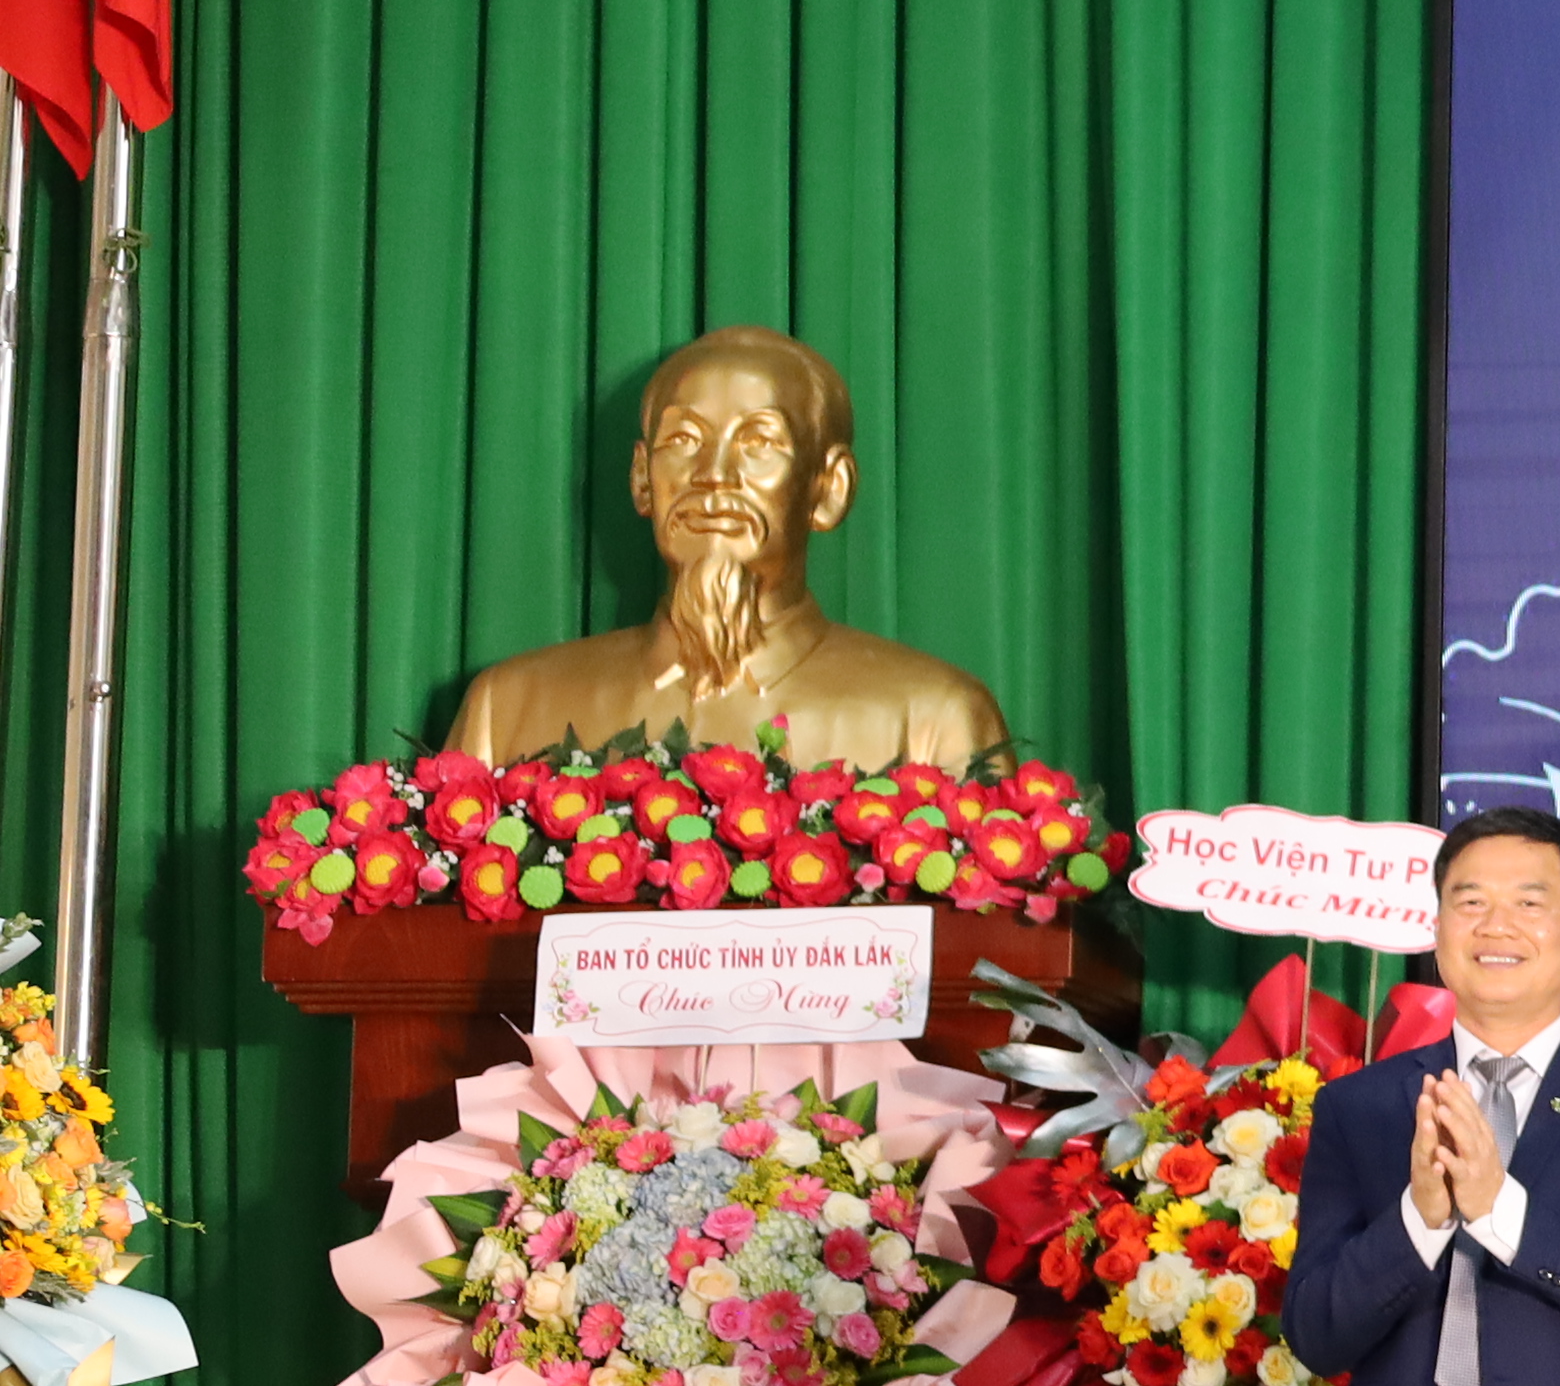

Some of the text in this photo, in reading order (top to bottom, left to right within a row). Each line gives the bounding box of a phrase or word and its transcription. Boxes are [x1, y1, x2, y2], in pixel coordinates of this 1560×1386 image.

[1165, 826, 1238, 866] Học
[1251, 836, 1329, 877] Viện
[1344, 848, 1395, 882] Tư
[1195, 877, 1310, 911] Chúc
[576, 934, 893, 972] BAN TỔ CHỨC TỈNH ỦY ĐẮK LẮK
[618, 977, 851, 1019] Chúc Mừng
